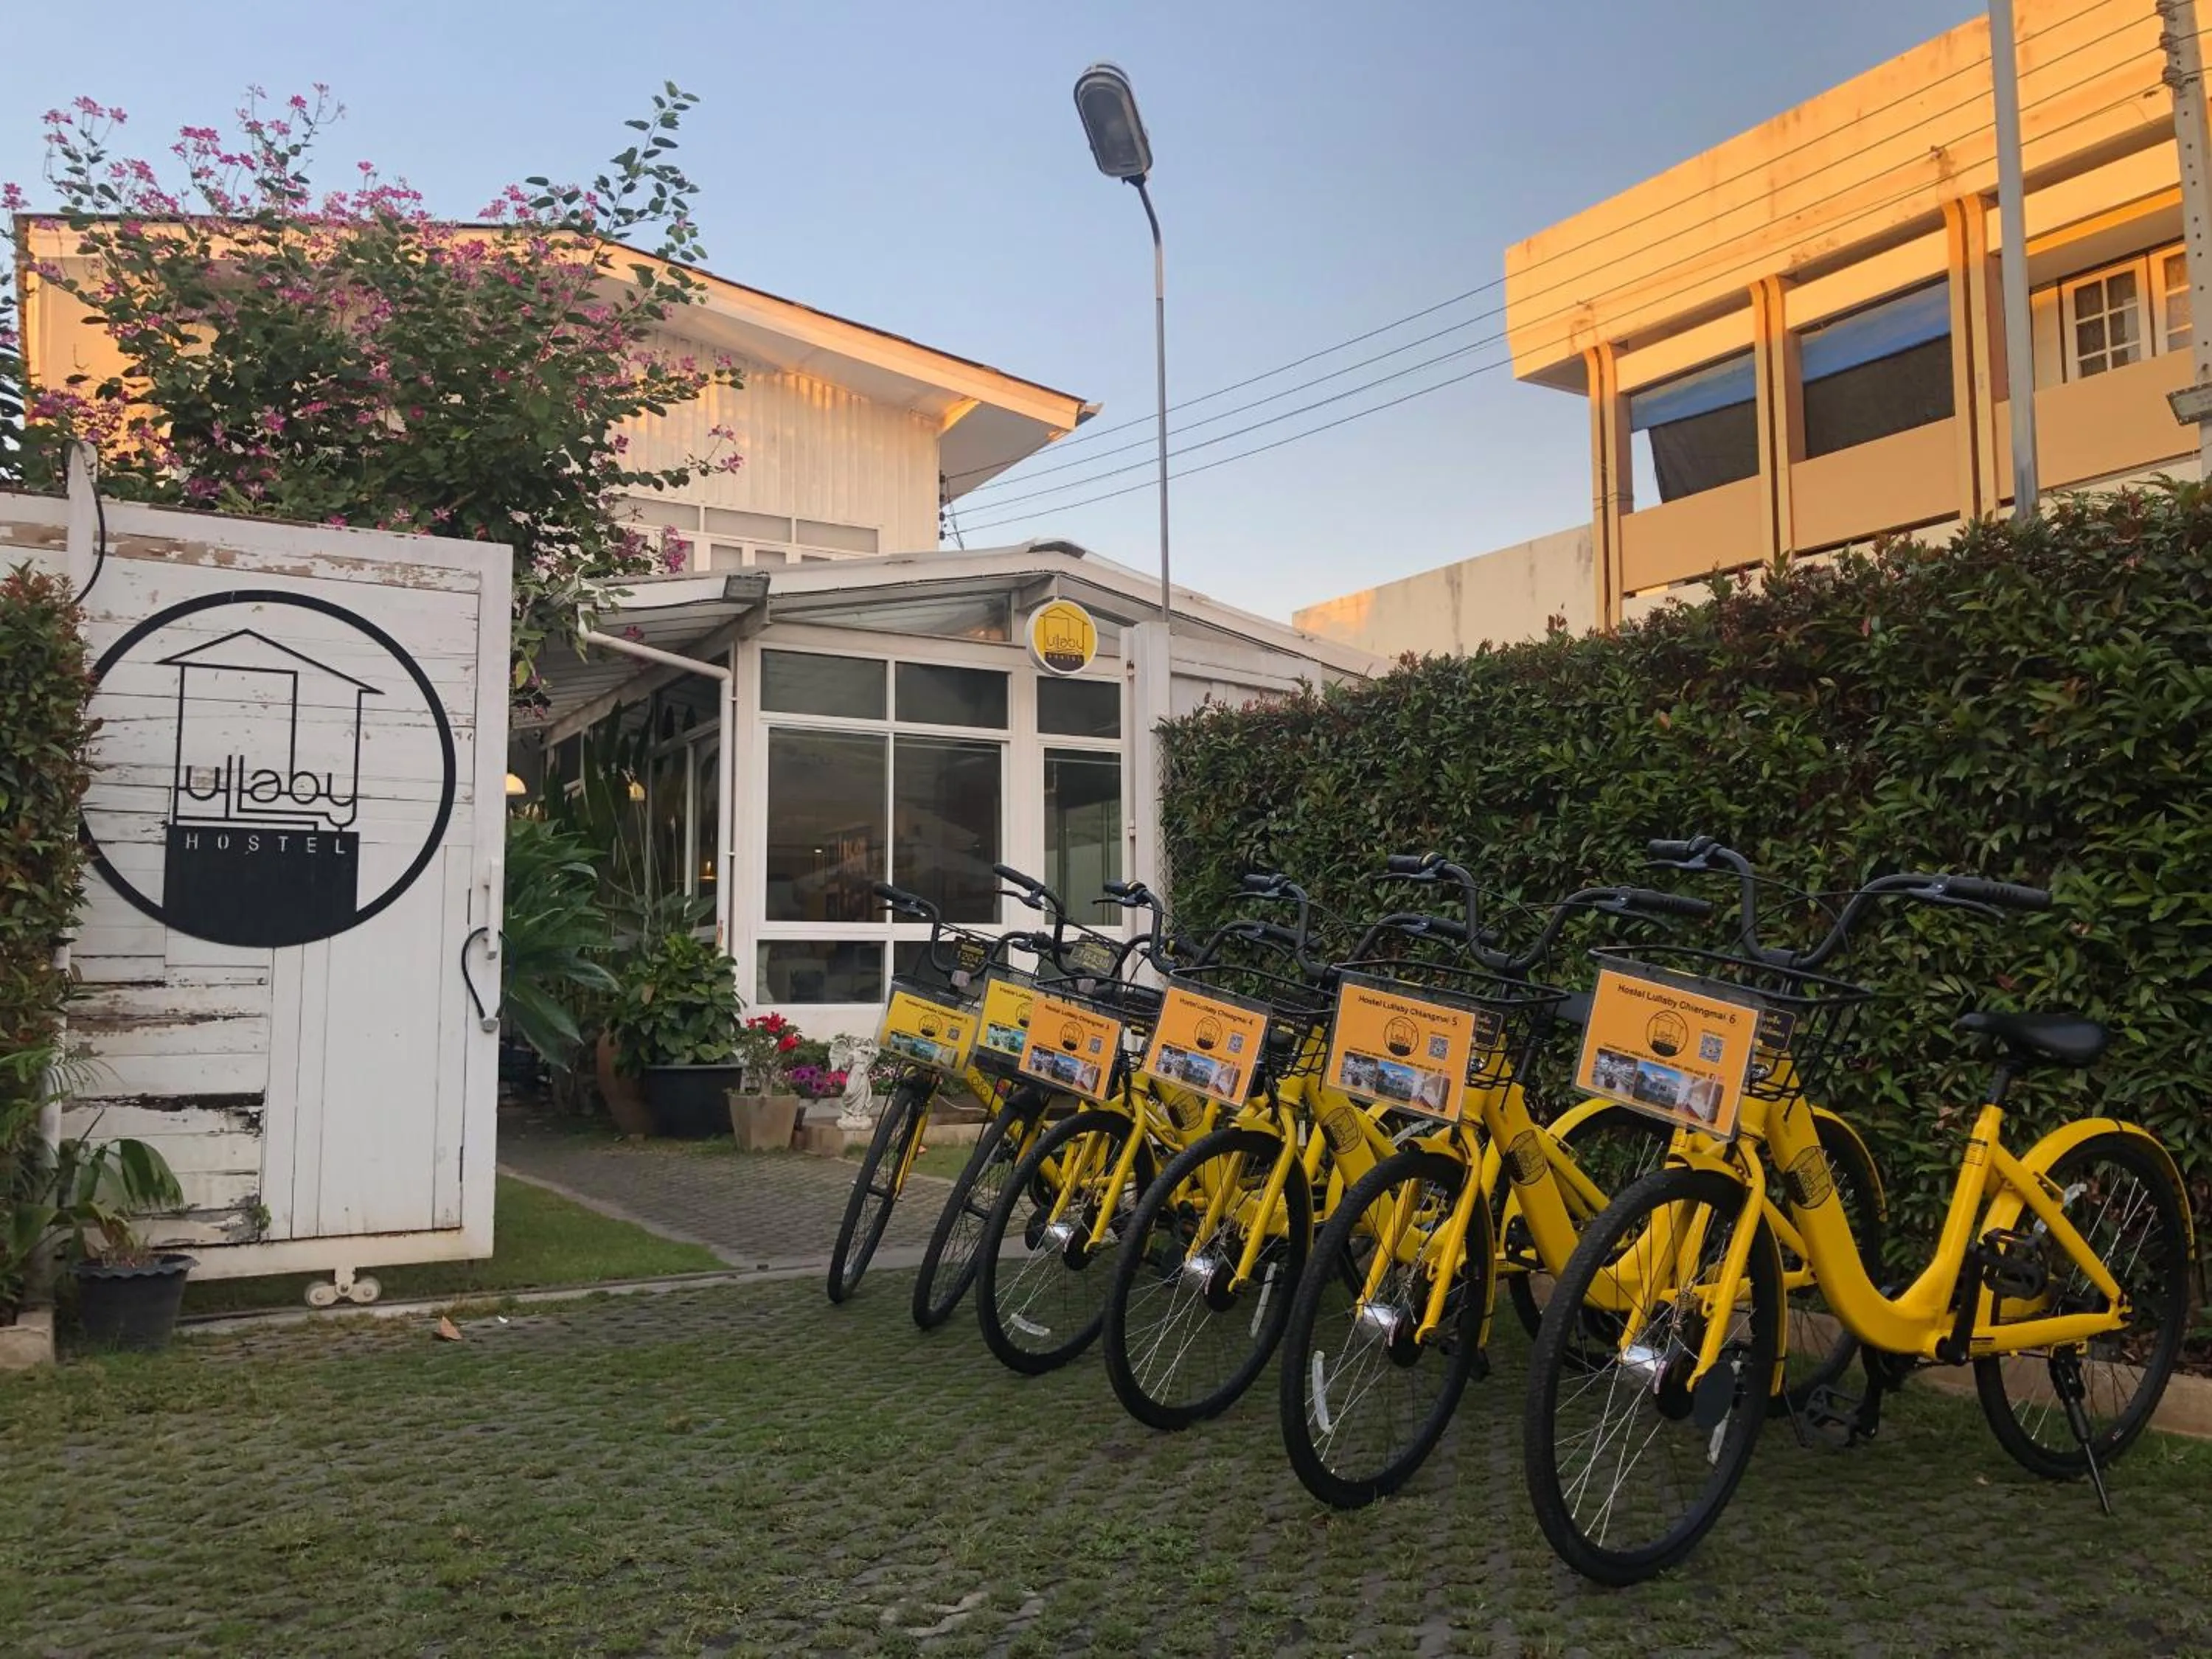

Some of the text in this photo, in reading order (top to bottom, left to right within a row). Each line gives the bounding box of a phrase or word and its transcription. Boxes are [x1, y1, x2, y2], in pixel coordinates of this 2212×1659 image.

[185, 834, 346, 855] HOSTEL
[1357, 995, 1382, 1007] Hostel
[1382, 1001, 1408, 1015] Lullaby
[1617, 983, 1645, 999] Hostel
[1646, 992, 1678, 1009] Lullaby
[1729, 1014, 1736, 1024] 6
